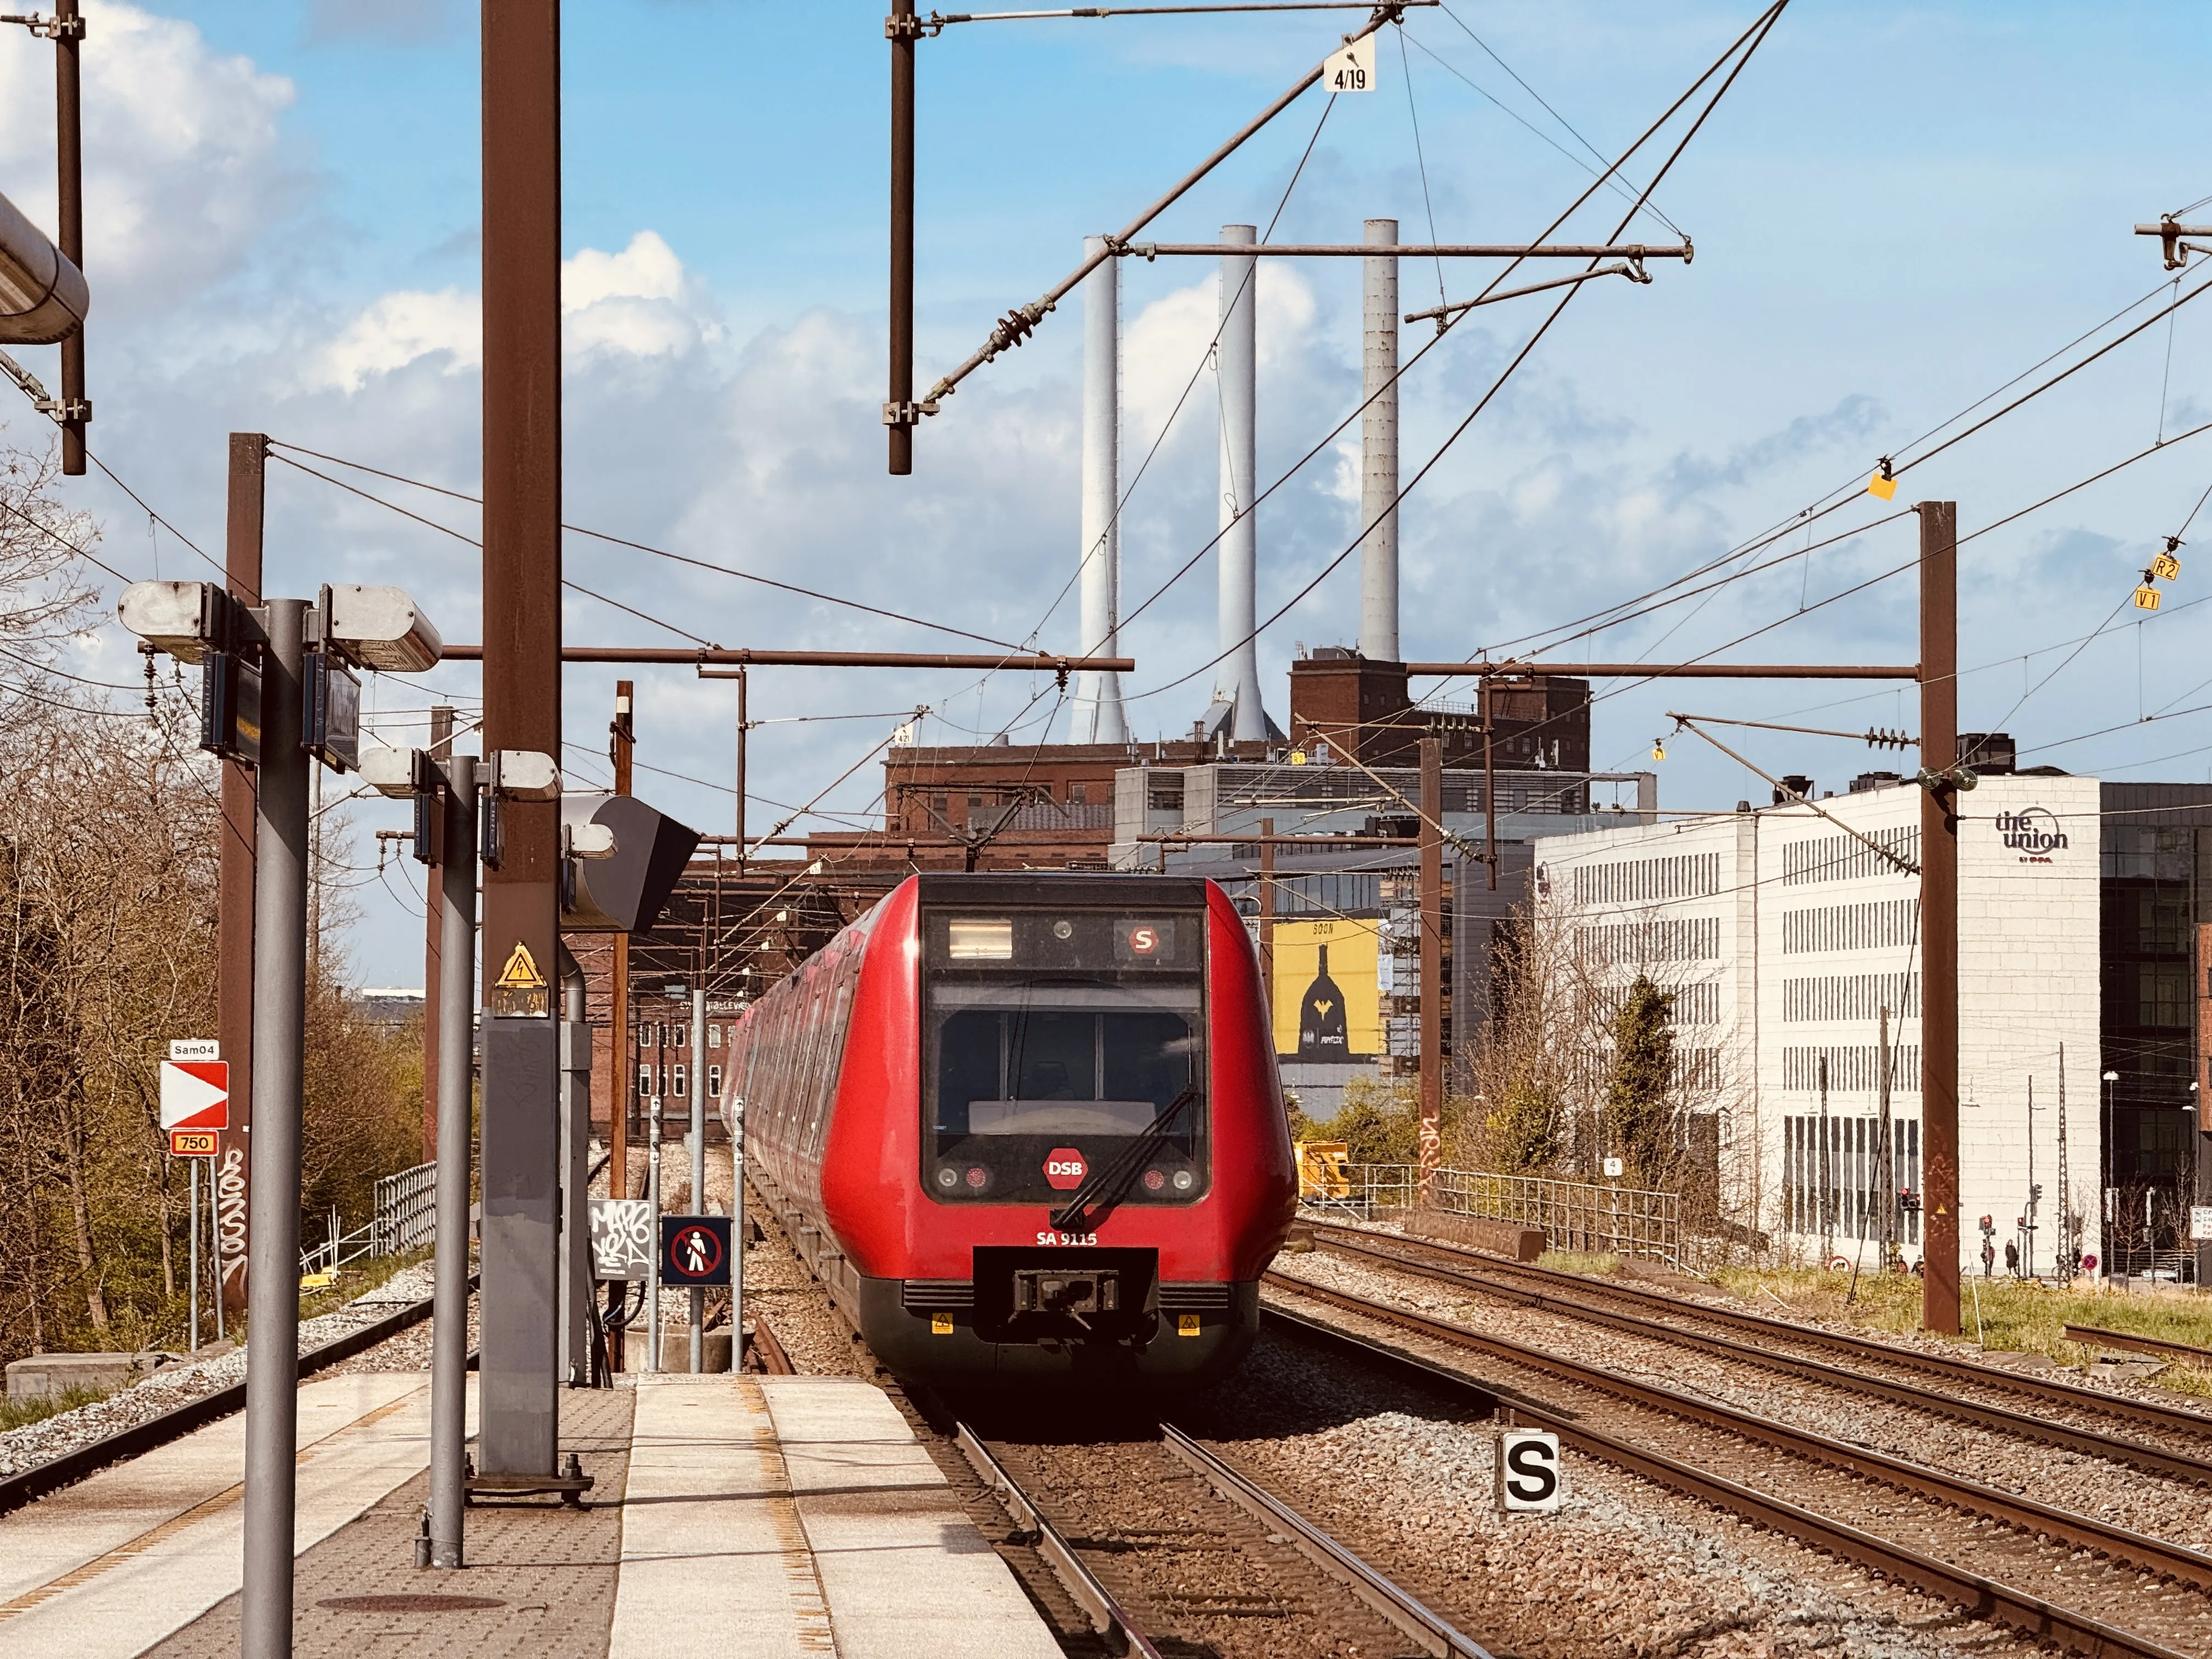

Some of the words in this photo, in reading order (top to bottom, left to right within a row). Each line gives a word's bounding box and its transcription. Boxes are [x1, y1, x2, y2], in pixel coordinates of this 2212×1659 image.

[1335, 69, 1365, 89] 4/19
[1995, 811, 2032, 832] the
[2003, 828, 2069, 849] union
[1136, 930, 1153, 949] S
[174, 1045, 215, 1056] Sam04
[180, 1137, 209, 1150] 750
[1048, 1161, 1083, 1176] DSB
[1036, 1232, 1057, 1245] SA
[1060, 1233, 1097, 1246] 9115
[1506, 1440, 1556, 1502] S
